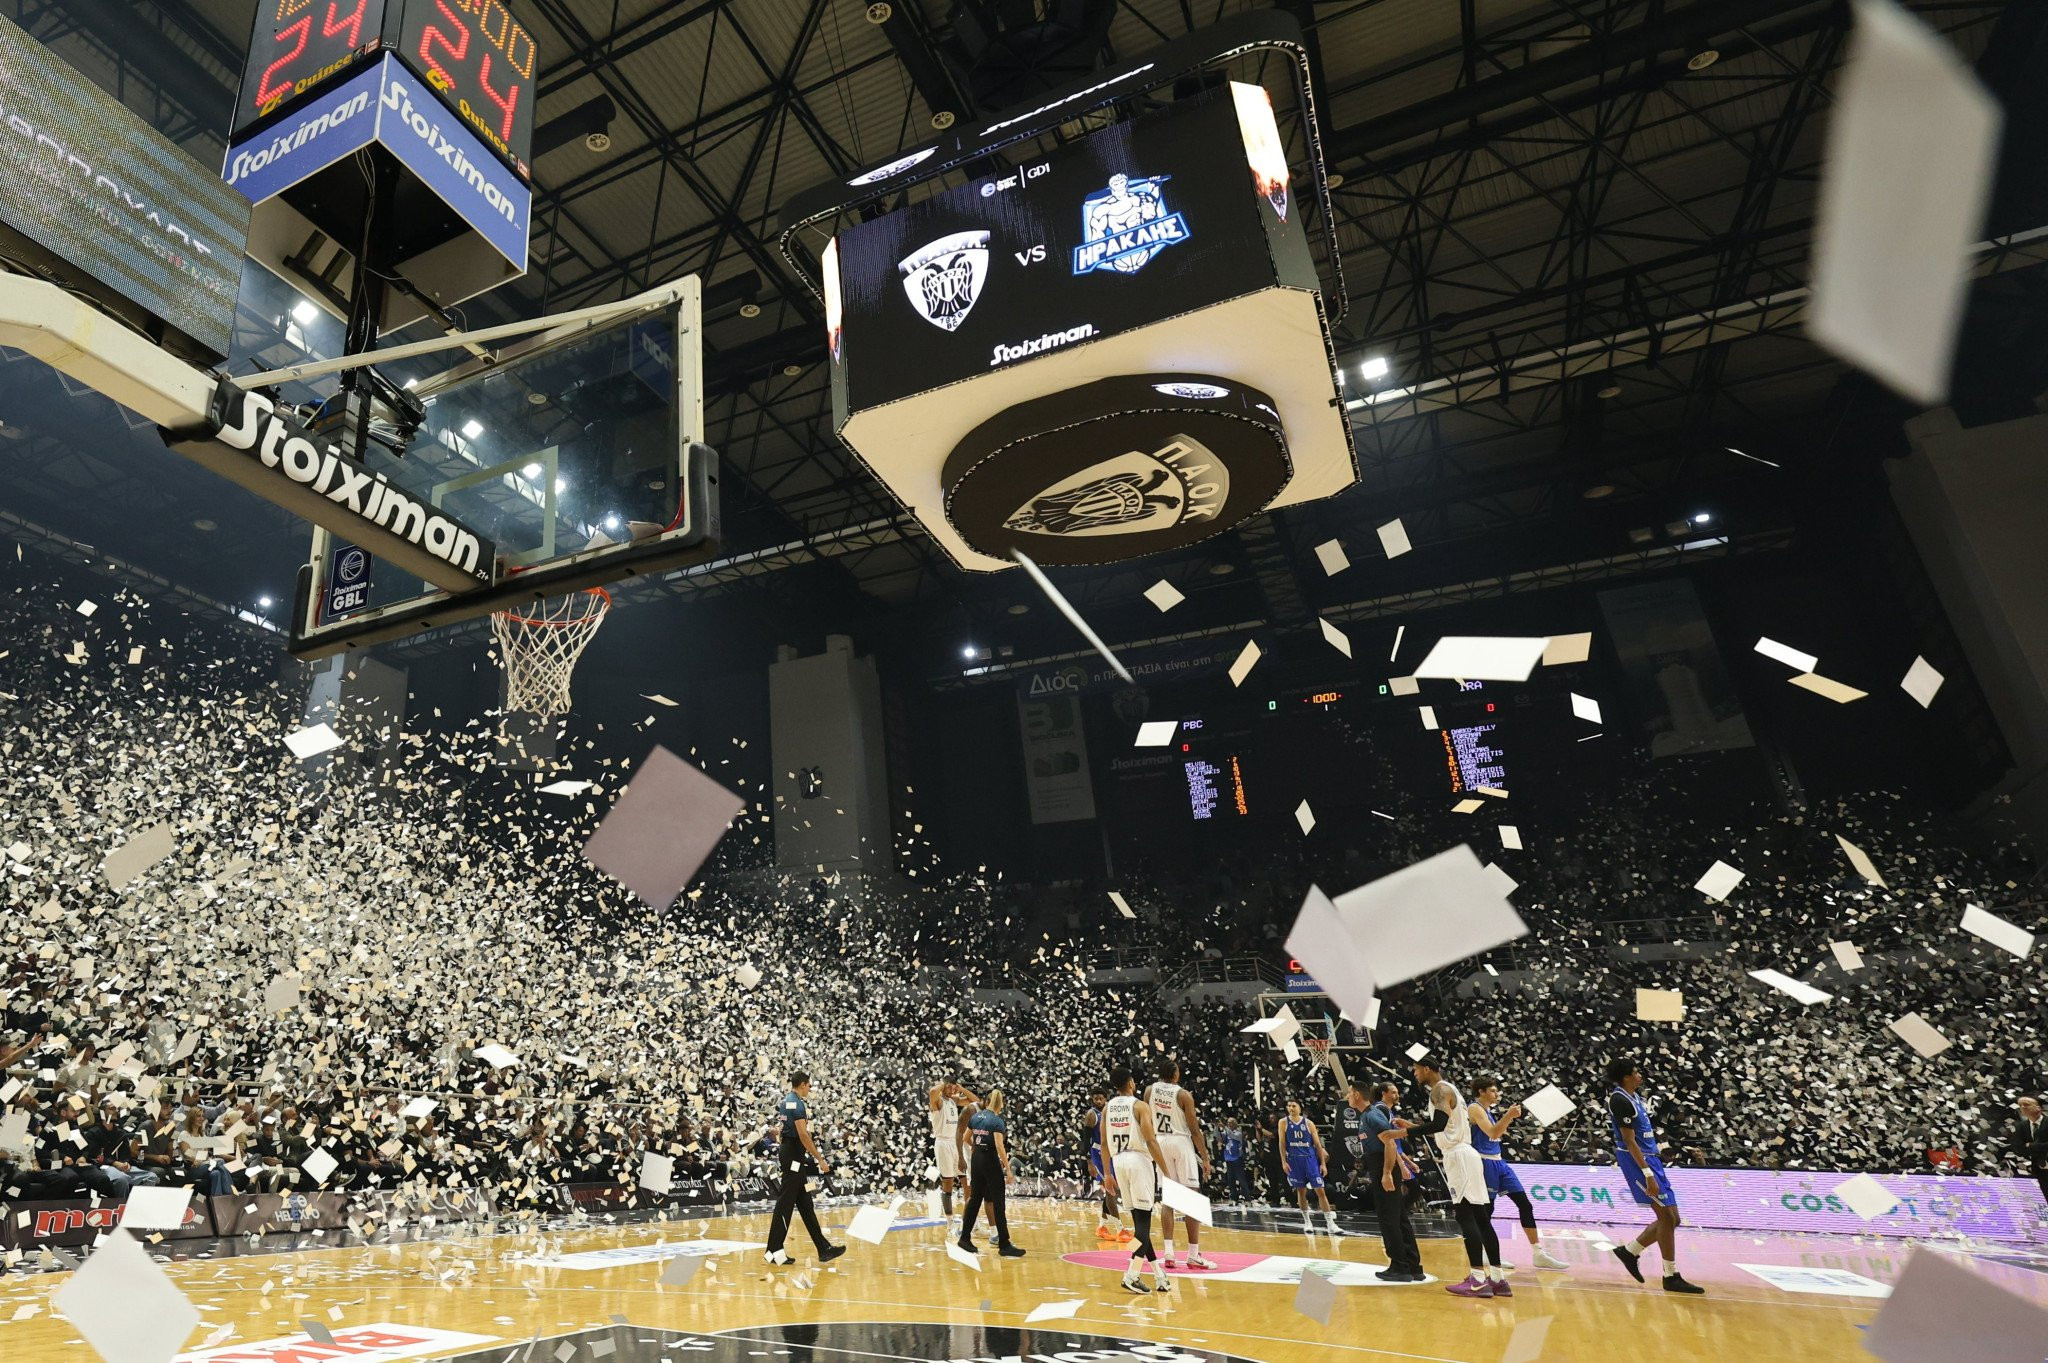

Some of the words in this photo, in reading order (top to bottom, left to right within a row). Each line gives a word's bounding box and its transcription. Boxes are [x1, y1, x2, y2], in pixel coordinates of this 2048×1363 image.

[294, 53, 352, 95] Quince
[458, 99, 508, 154] Quince
[227, 91, 369, 186] Stoiximan
[383, 81, 516, 223] Stoiximan
[1027, 162, 1050, 178] GD1
[1078, 218, 1183, 270] ΗΡΑΚΛΗΣ
[1015, 245, 1047, 266] VS
[947, 321, 957, 329] BC
[990, 323, 1093, 366] Stoiximan
[216, 391, 480, 573] Stoiximan
[476, 569, 489, 580] 21+
[1112, 484, 1138, 514] ΠΑΟΚ
[1019, 510, 1043, 531] 1926
[333, 582, 367, 596] Stoiximan
[333, 591, 364, 610] GBL
[1029, 671, 1079, 697] Διός
[1103, 663, 1162, 681] ΠΡΤΑΣΙΑ
[1379, 684, 1387, 694] 0
[1268, 700, 1276, 710] 0
[1313, 692, 1337, 704] 10:00
[1487, 703, 1494, 712] 0
[1183, 719, 1203, 731] PBC
[1183, 744, 1189, 752] 0
[1288, 979, 1320, 987] Stoixim
[1155, 1088, 1174, 1097] MOORE
[1110, 1105, 1131, 1113] BROWN
[1156, 1112, 1173, 1134] 26
[1294, 1131, 1303, 1139] 10
